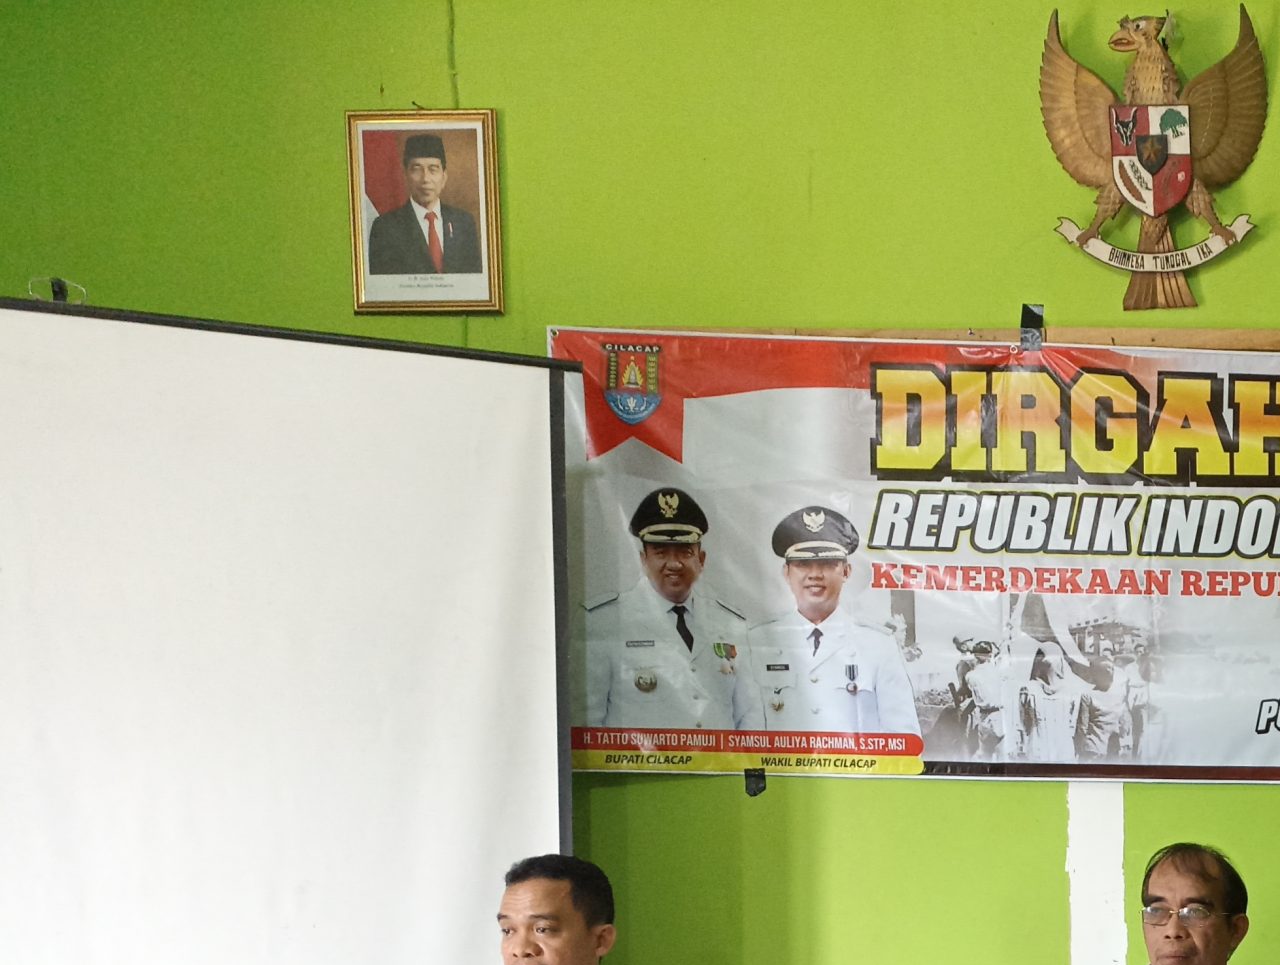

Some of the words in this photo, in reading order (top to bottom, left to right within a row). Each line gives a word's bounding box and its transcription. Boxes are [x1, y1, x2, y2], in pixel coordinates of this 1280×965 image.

[1196, 243, 1213, 261] IKA
[605, 343, 660, 353] CILACAP
[868, 489, 1143, 556] REPUBLIK
[871, 562, 1172, 597] KEMERDEKAAN
[583, 732, 593, 744] H.
[597, 732, 628, 745] TATTO
[630, 733, 678, 746] SUWARTO
[681, 734, 715, 747] PAMUJI
[728, 735, 771, 748] SYAMSUL
[774, 736, 807, 749] AULIYA
[809, 737, 857, 750] RACHMAN,
[605, 754, 643, 764] BUPATI
[646, 755, 692, 765] CILACAP
[761, 757, 793, 767] WAKIL
[795, 758, 831, 768] BUPATI
[833, 758, 877, 769] CILACAP
